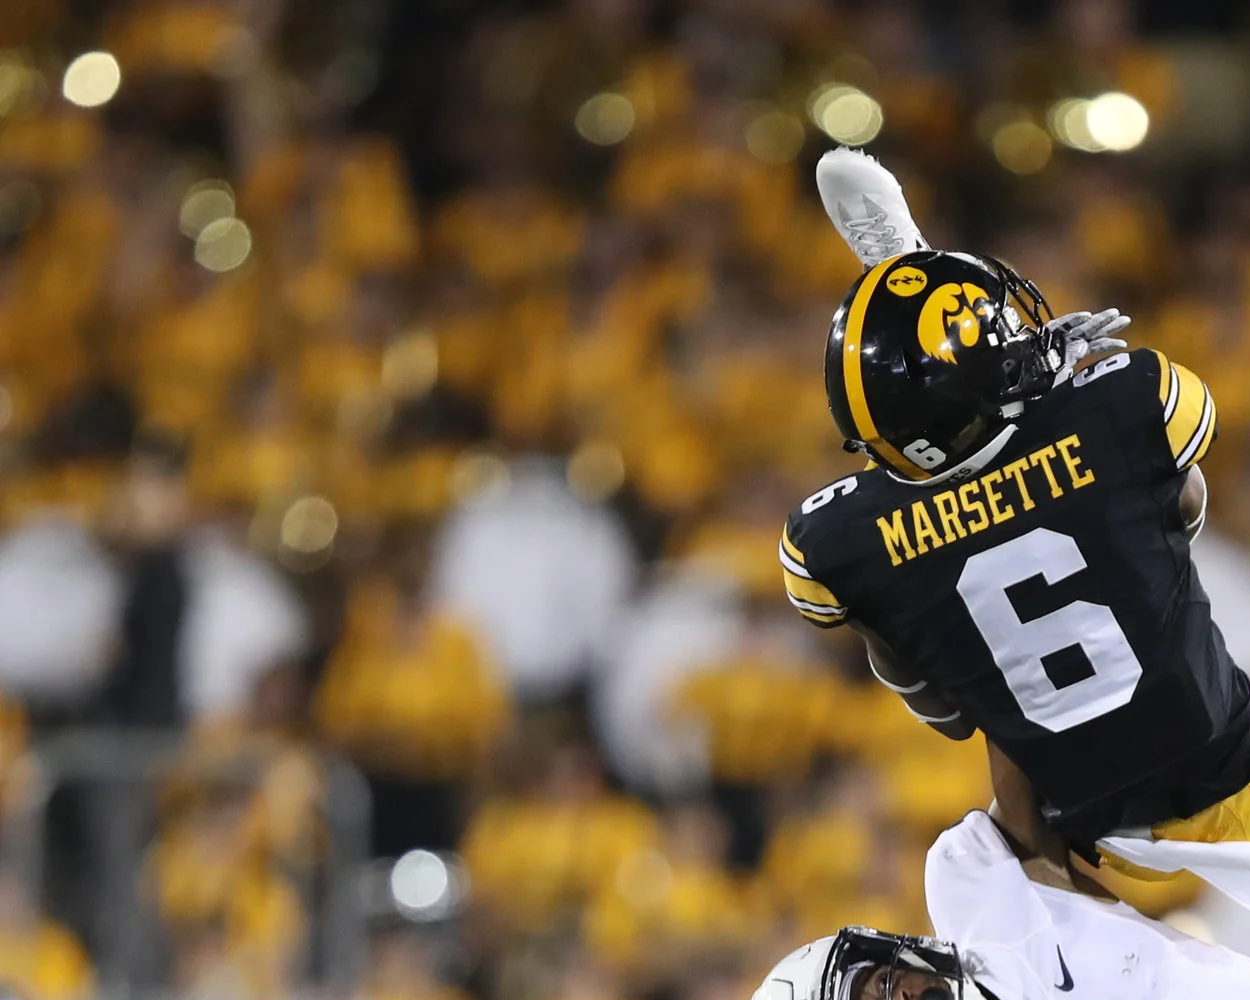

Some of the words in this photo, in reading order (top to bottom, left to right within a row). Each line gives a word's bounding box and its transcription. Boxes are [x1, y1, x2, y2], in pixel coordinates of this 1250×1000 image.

[1073, 352, 1130, 388] 6
[903, 439, 947, 470] 6
[801, 475, 858, 515] 6
[876, 433, 1096, 567] MARSETTE
[956, 527, 1144, 734] 6
